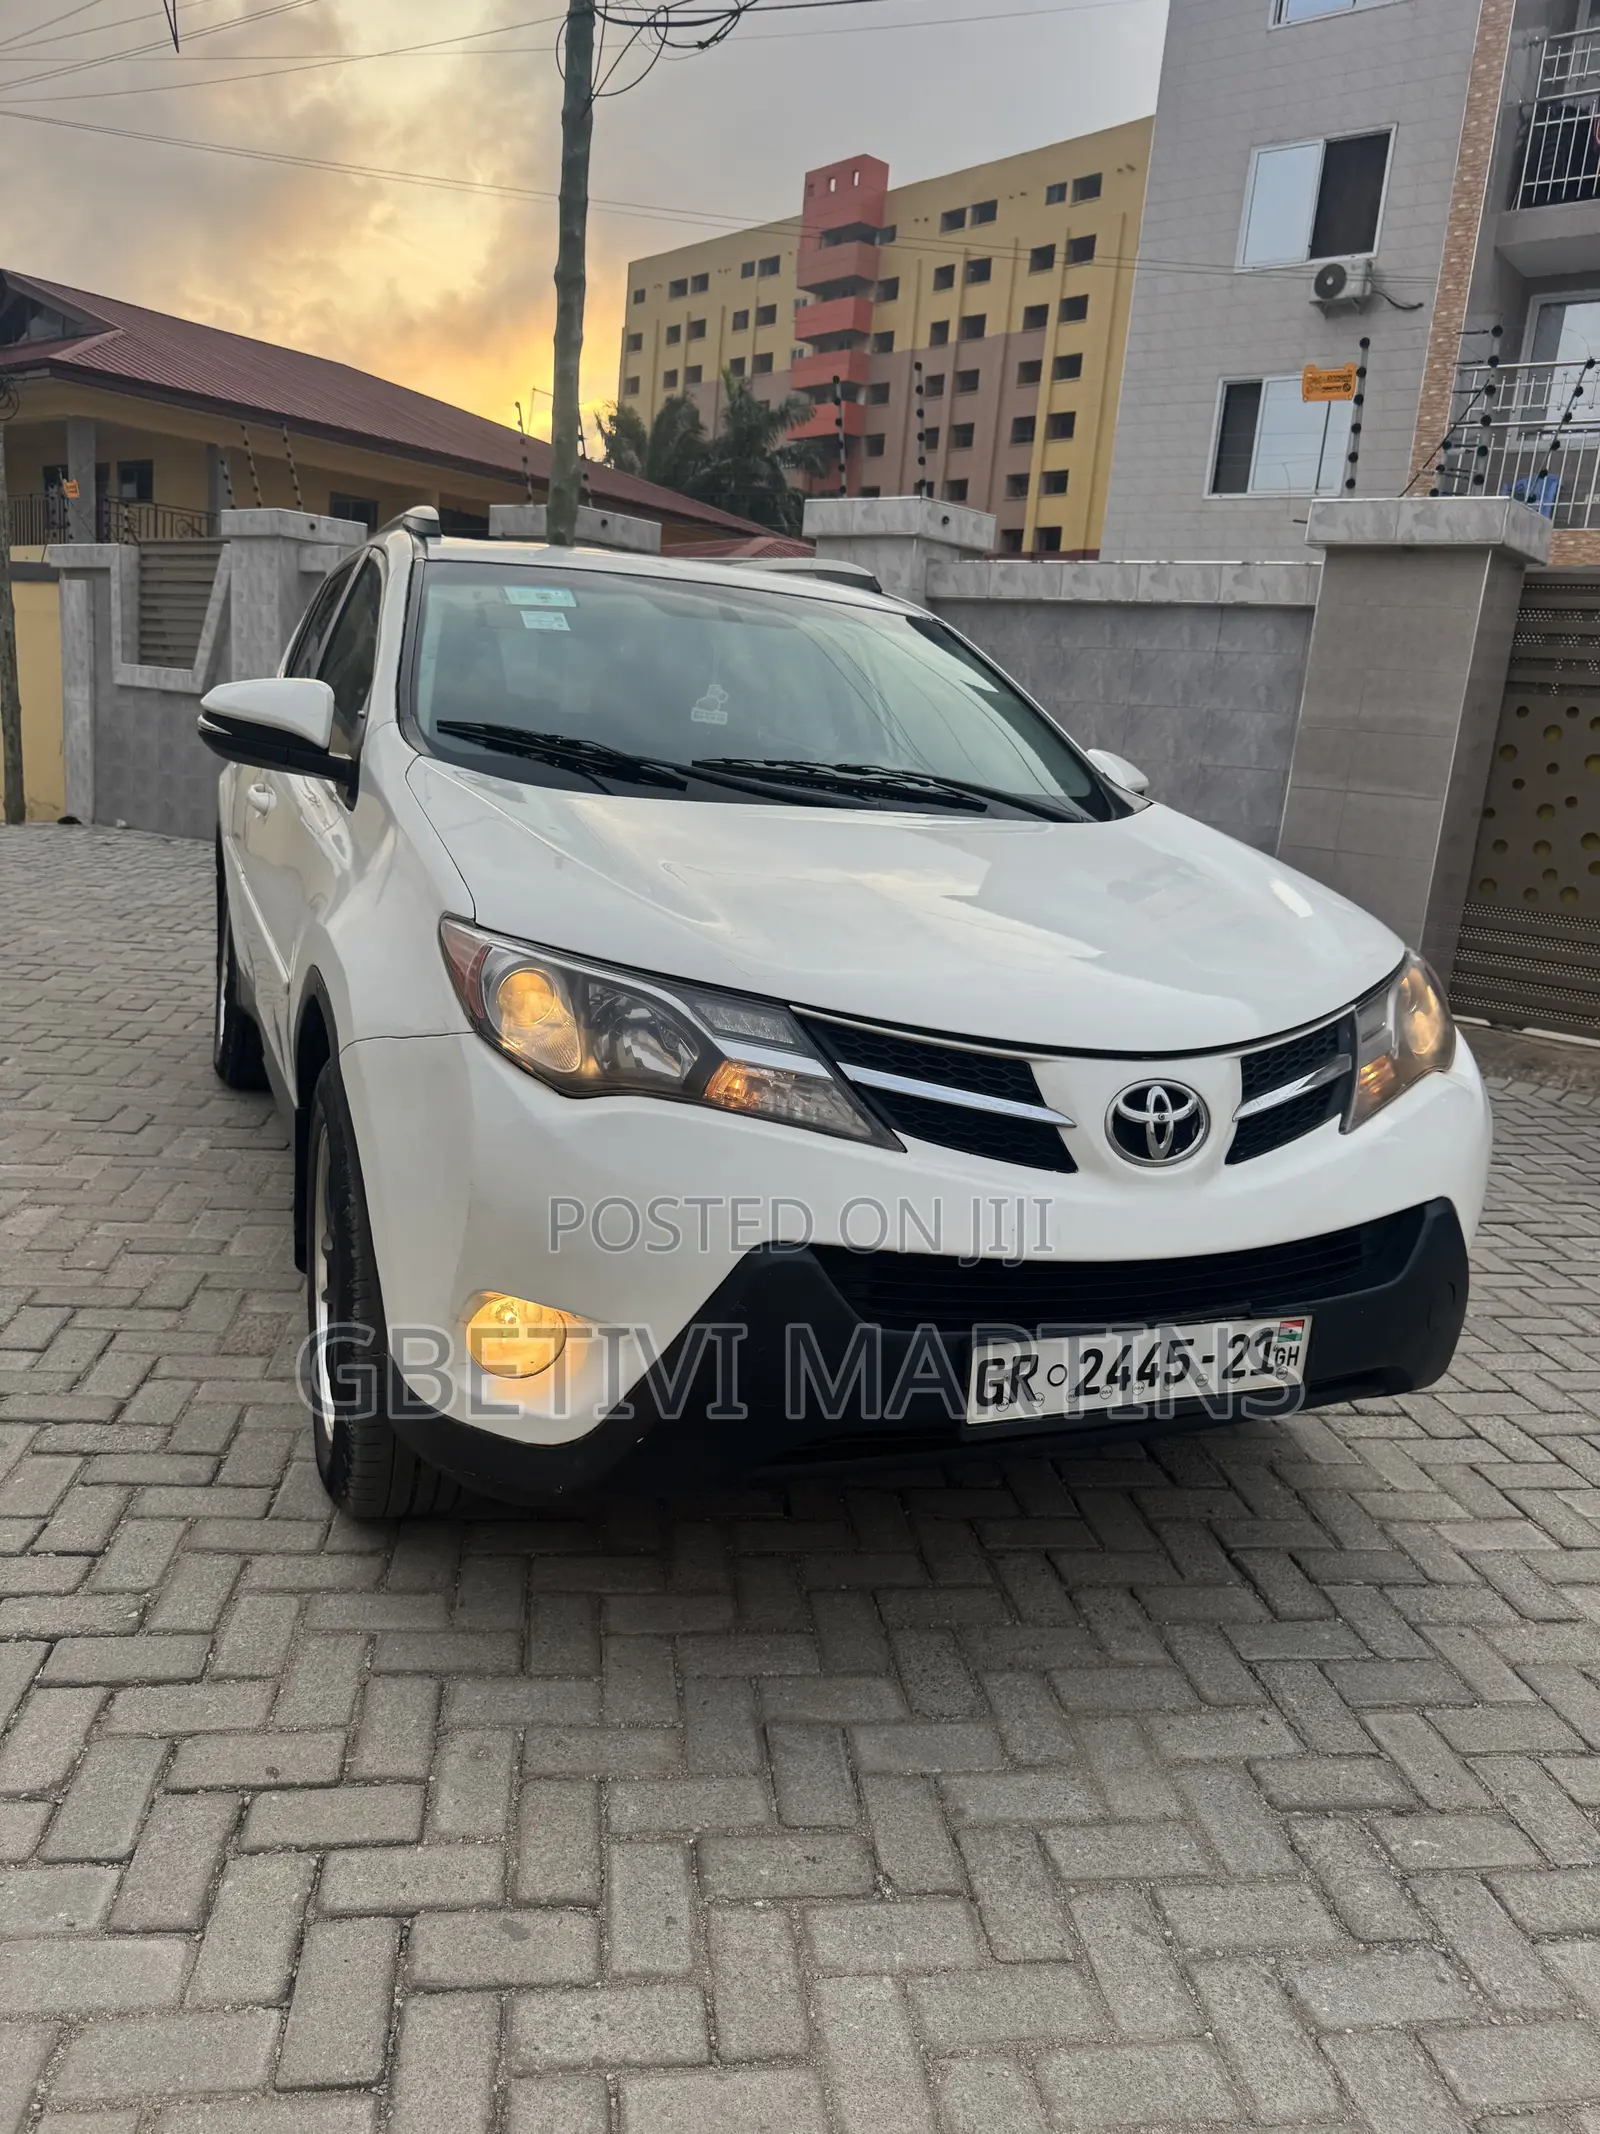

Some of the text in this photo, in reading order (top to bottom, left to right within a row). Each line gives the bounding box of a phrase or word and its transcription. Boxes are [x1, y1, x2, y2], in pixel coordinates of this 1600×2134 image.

[976, 1330, 1274, 1406] GR 2445-21
[1275, 1345, 1300, 1367] GH
